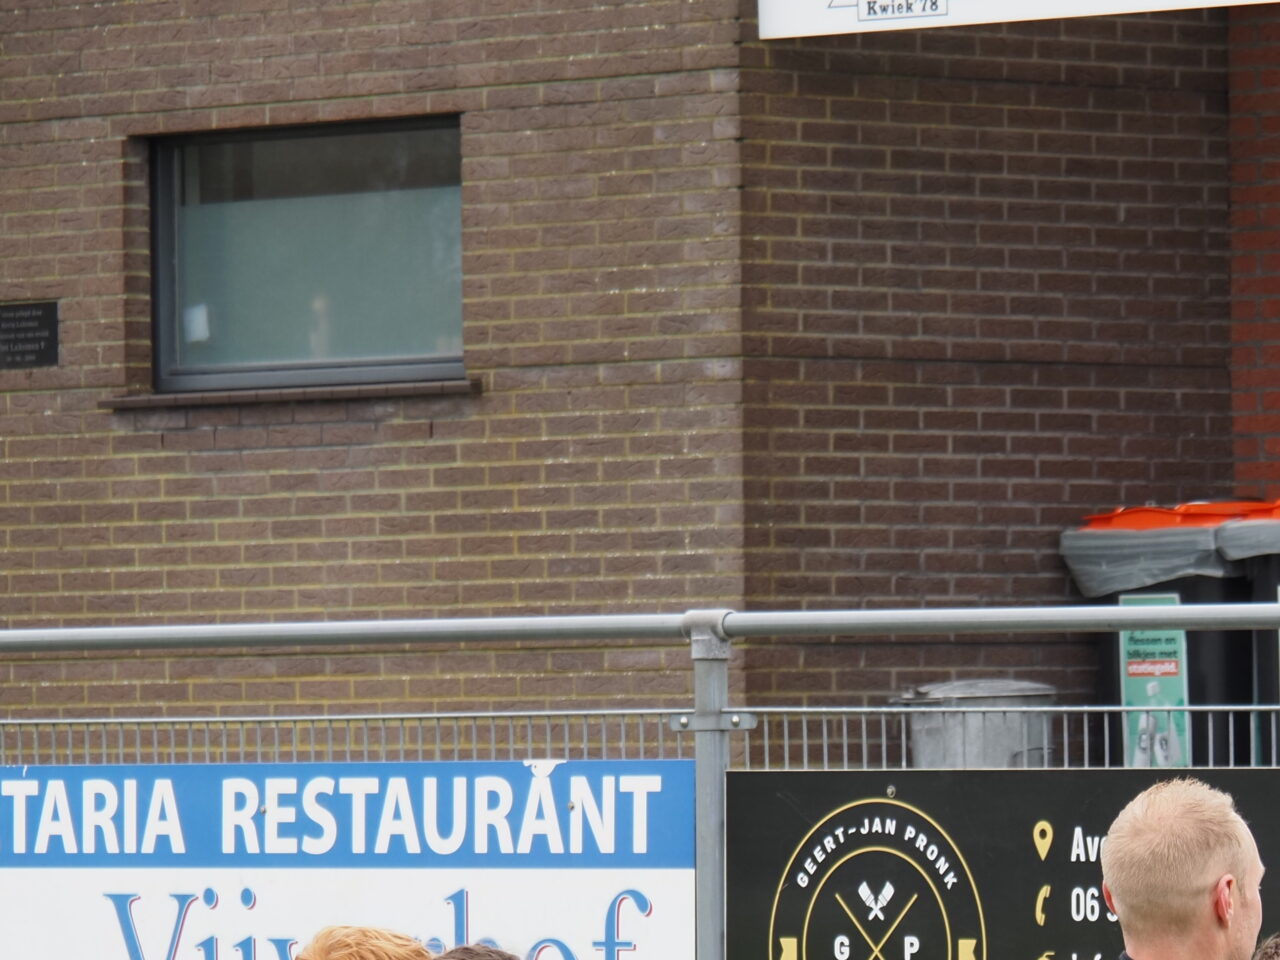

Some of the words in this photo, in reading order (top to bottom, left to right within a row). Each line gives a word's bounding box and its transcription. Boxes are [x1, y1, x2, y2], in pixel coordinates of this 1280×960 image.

[867, 0, 913, 15] Kwiek
[1, 779, 186, 854] TARIA
[221, 775, 662, 854] RESTAURANT
[796, 818, 896, 888] GEERT-JAN
[904, 825, 958, 890] PRONK
[1071, 887, 1100, 922] 06
[834, 935, 850, 960] G
